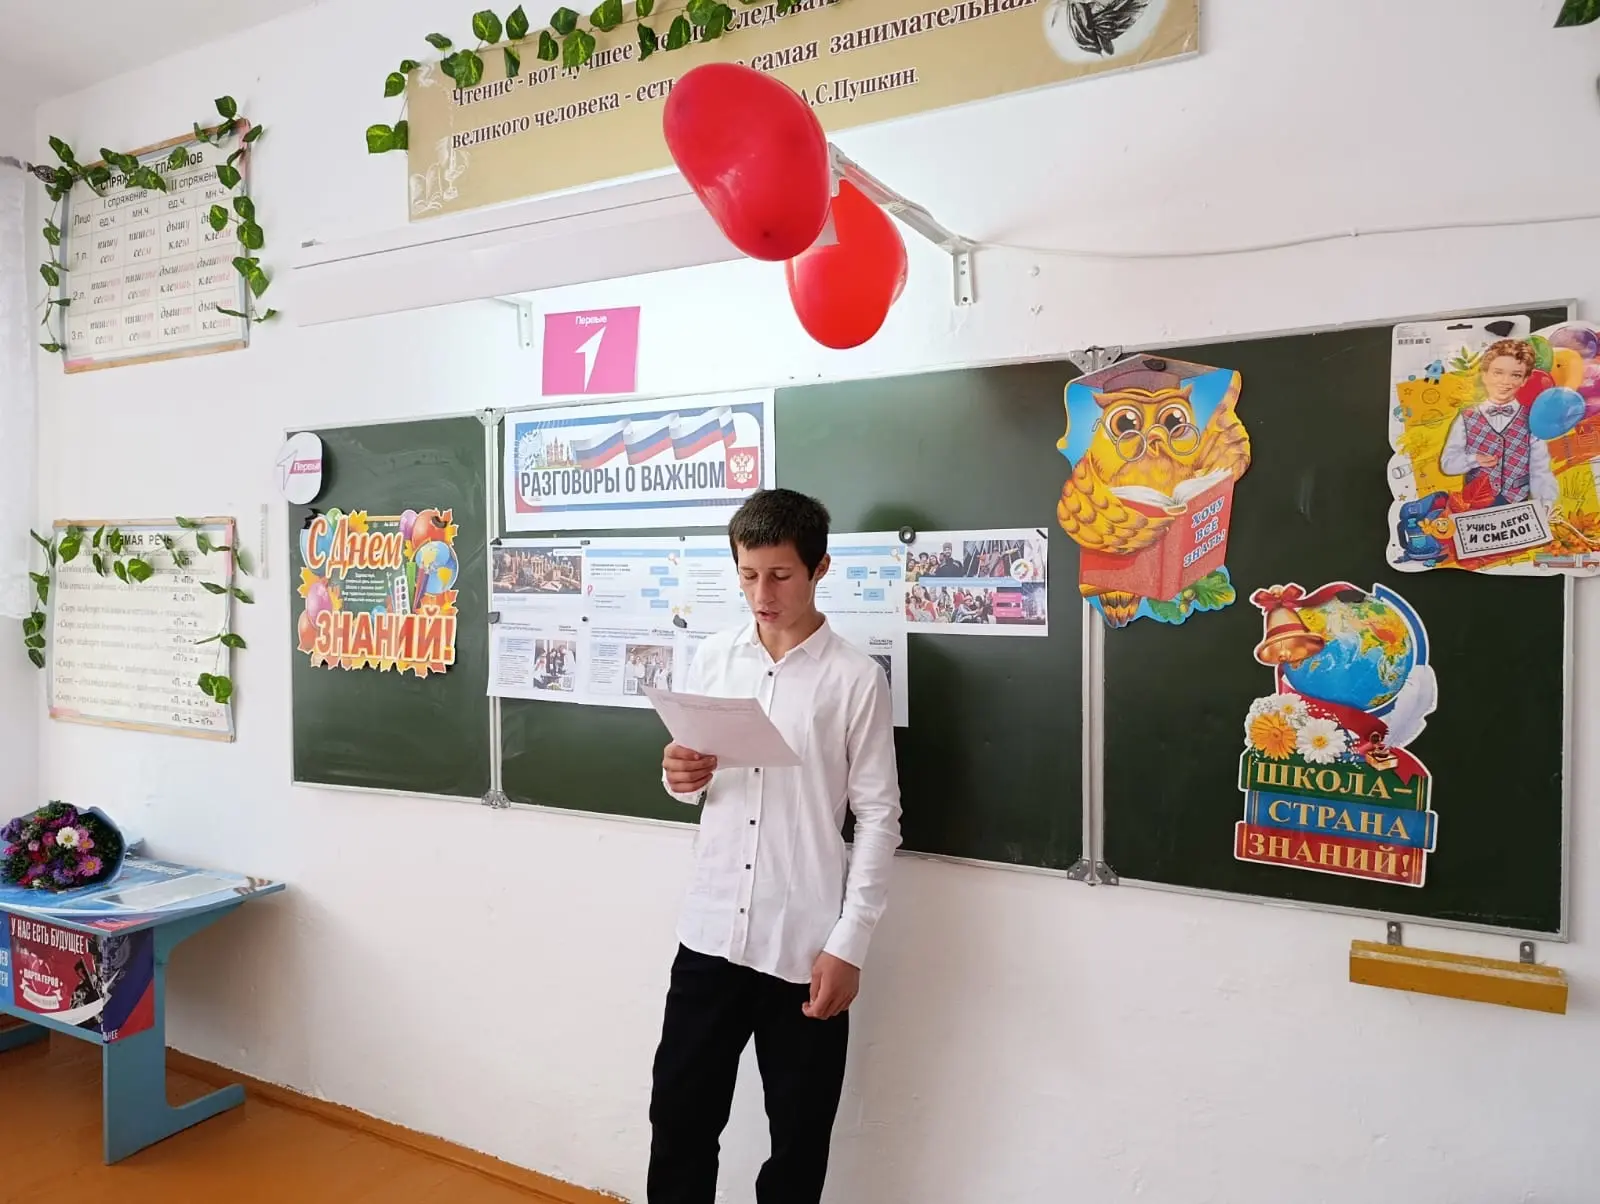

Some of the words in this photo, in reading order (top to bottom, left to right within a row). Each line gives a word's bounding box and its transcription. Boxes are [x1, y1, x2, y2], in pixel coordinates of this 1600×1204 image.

[452, 76, 514, 106] Чтение
[528, 65, 558, 87] вот
[561, 43, 633, 80] лучшее
[452, 115, 530, 149] великого
[535, 92, 619, 127] человека
[751, 41, 819, 72] самая
[156, 152, 203, 174] ГЛАЛОВ
[179, 171, 217, 189] спряжен
[107, 189, 148, 209] спряжение
[73, 213, 91, 226] Лицо
[575, 315, 608, 327] Первые
[521, 466, 620, 497] РАЗГОВОРЫ
[625, 467, 635, 492] О
[640, 461, 725, 492] ВАЖНОМ
[1191, 496, 1225, 529] ХОЧУ
[1466, 520, 1497, 532] УЧИСЬ
[1500, 512, 1530, 529] ЛЕГКО
[106, 535, 144, 546] ПЯМАЯ
[306, 517, 331, 569] С
[326, 516, 404, 579] Днем
[1184, 530, 1227, 568] ЗНАТЬ!
[1469, 534, 1478, 544] И
[315, 606, 457, 665] ЗНАНИЙ!
[1268, 800, 1411, 840] СТРАНА
[1248, 832, 1411, 879] ЗНАНИЙ!
[11, 917, 16, 936] У
[17, 921, 31, 940] НАС
[32, 924, 49, 945] ЕСТЬ
[50, 928, 84, 954] БУДУЩЕЕ
